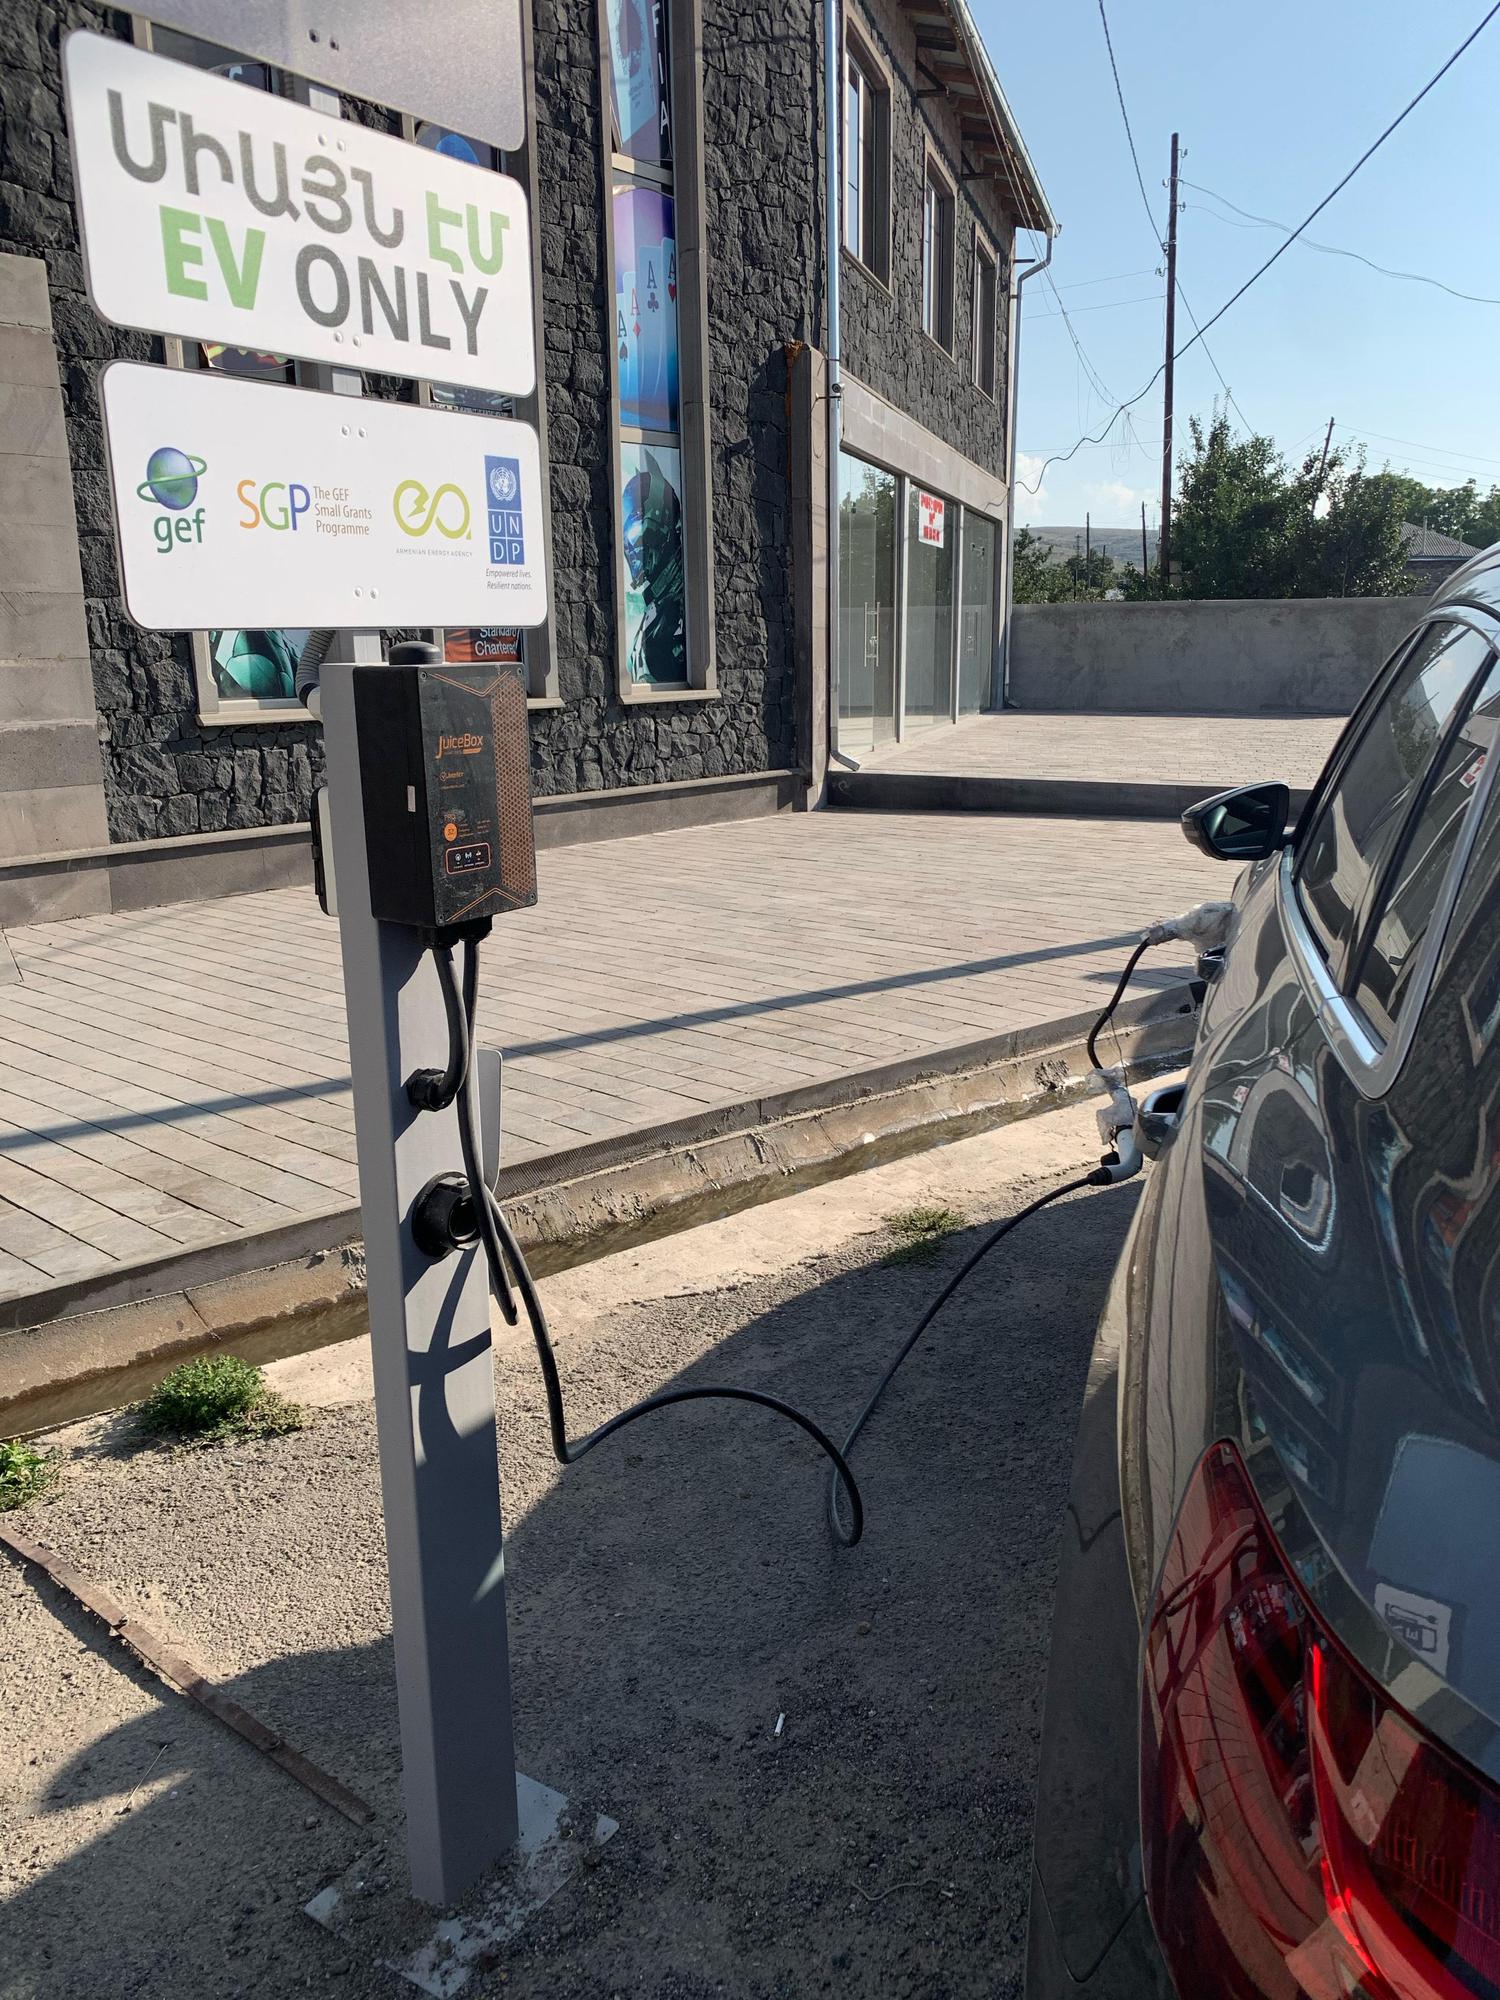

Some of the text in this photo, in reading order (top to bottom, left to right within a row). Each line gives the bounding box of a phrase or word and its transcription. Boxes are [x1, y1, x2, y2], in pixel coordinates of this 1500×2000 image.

[159, 205, 489, 357] EV ONLY
[647, 260, 657, 289] A
[631, 287, 640, 316] A
[617, 310, 627, 337] A
[237, 479, 310, 531] SGP
[313, 485, 350, 502] The GEF
[314, 503, 373, 520] Small Grants
[153, 508, 205, 553] gef
[316, 520, 370, 536] Programme
[485, 568, 518, 578] Empowered
[487, 581, 510, 590] Resilient
[474, 640, 519, 656] Chartered
[435, 733, 483, 759] JuiceBox
